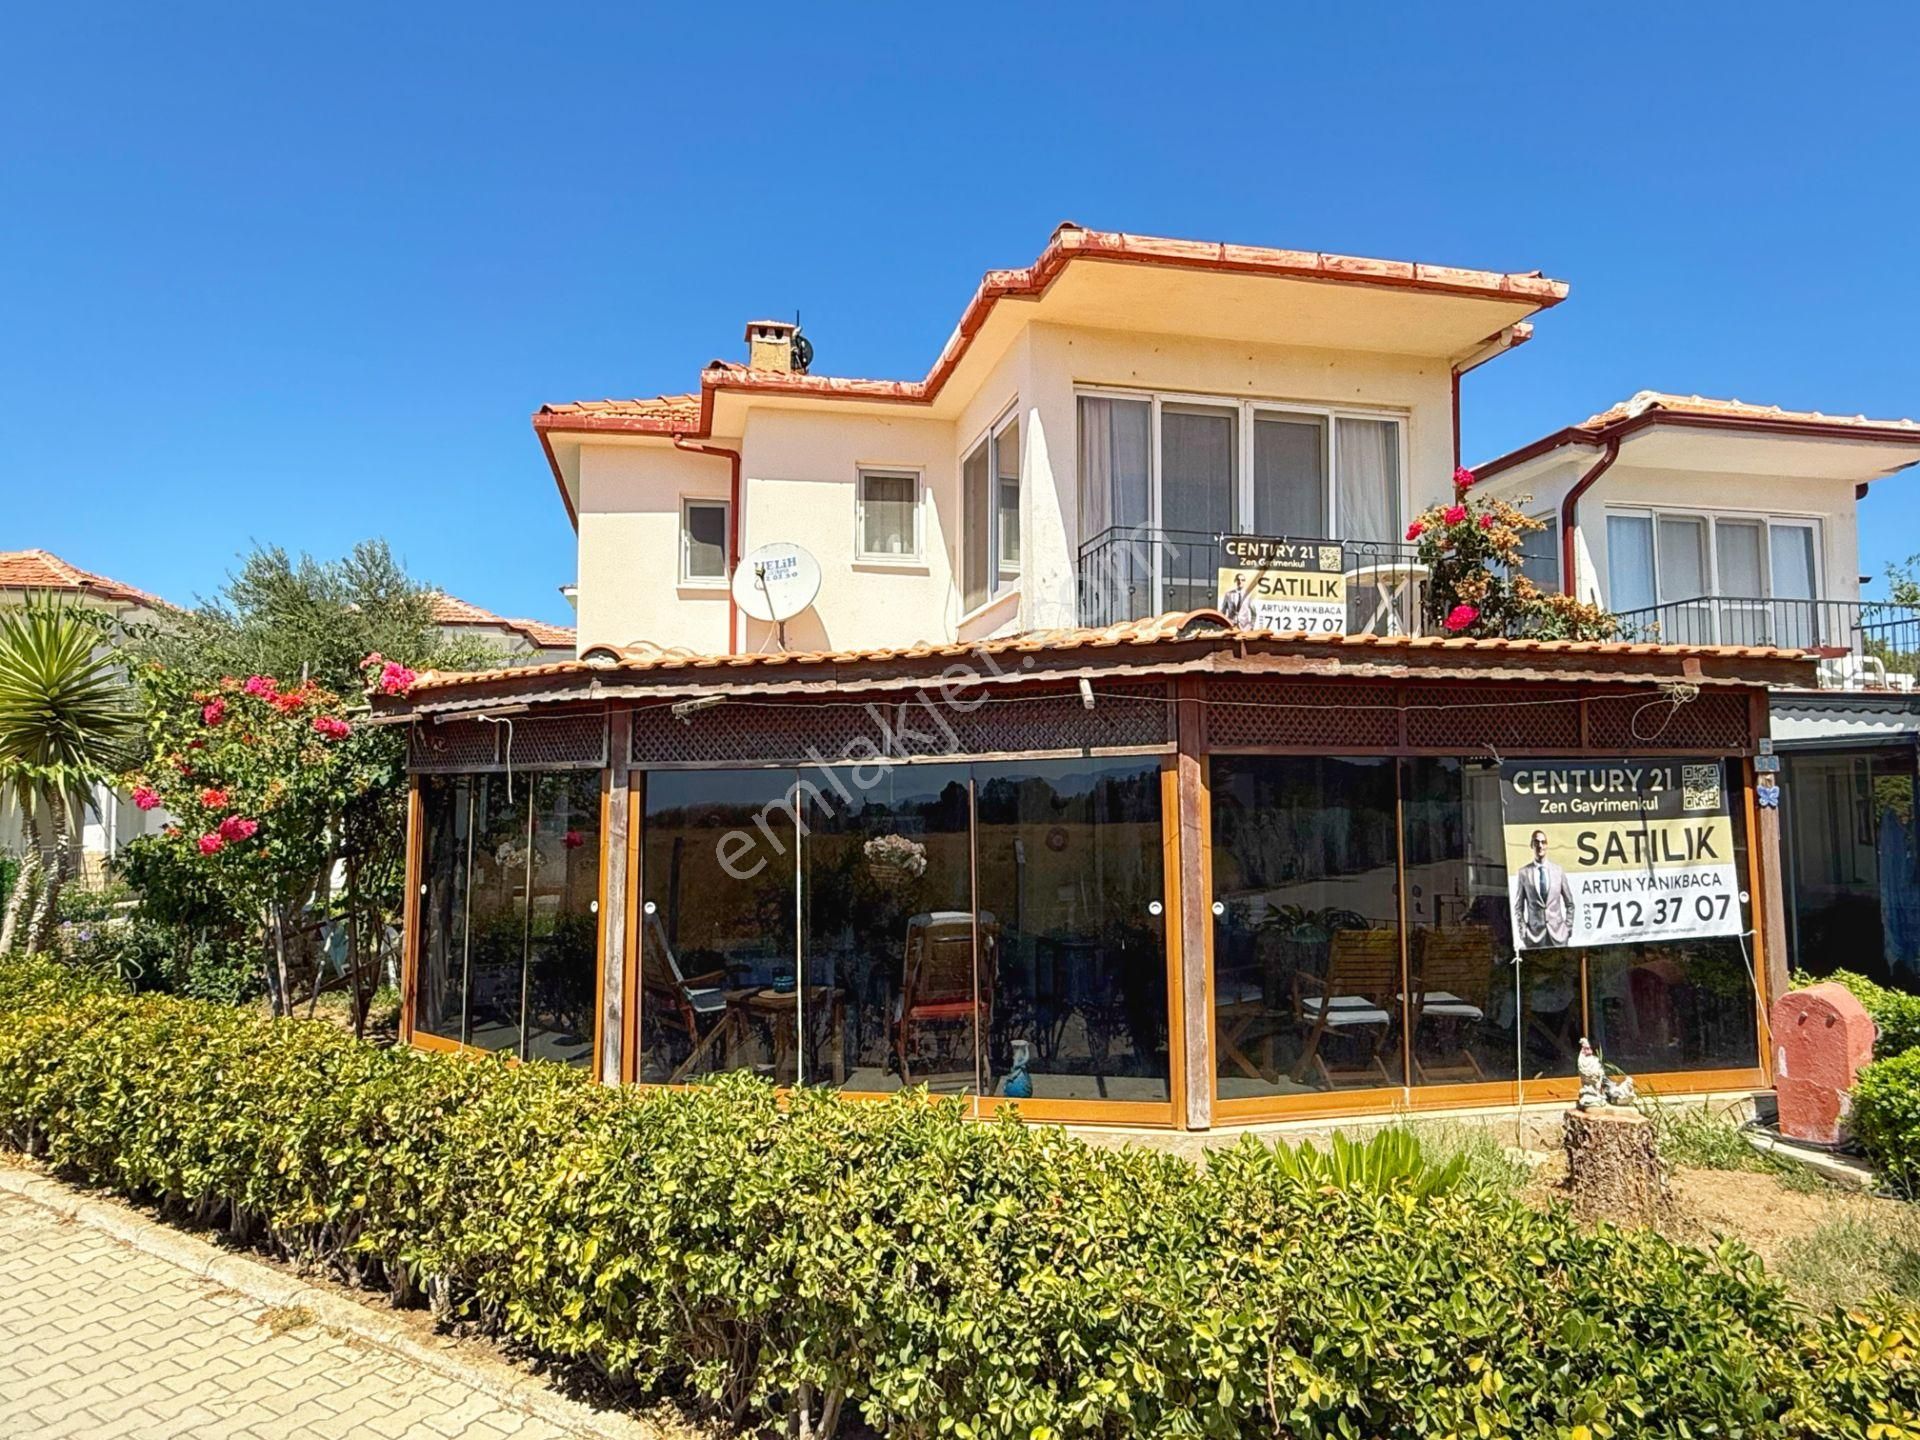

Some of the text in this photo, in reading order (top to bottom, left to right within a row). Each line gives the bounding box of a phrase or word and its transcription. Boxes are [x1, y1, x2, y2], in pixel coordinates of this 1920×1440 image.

[1226, 542, 1315, 559] CENTURY 21
[1240, 557, 1257, 567] Zen
[1257, 577, 1338, 598] SATILIK
[1261, 604, 1341, 615] ARTUN YANIKBACA
[1265, 616, 1291, 630] 712
[1298, 617, 1317, 631] 37
[1323, 618, 1343, 632] 07
[1513, 767, 1672, 795] CENTURY 21
[1540, 796, 1659, 815] Zen Gayrimenkul
[1576, 825, 1719, 867] SATILIK
[1582, 872, 1722, 895] ARTUN YANIKBACA
[1592, 894, 1731, 929] 712 37 07
